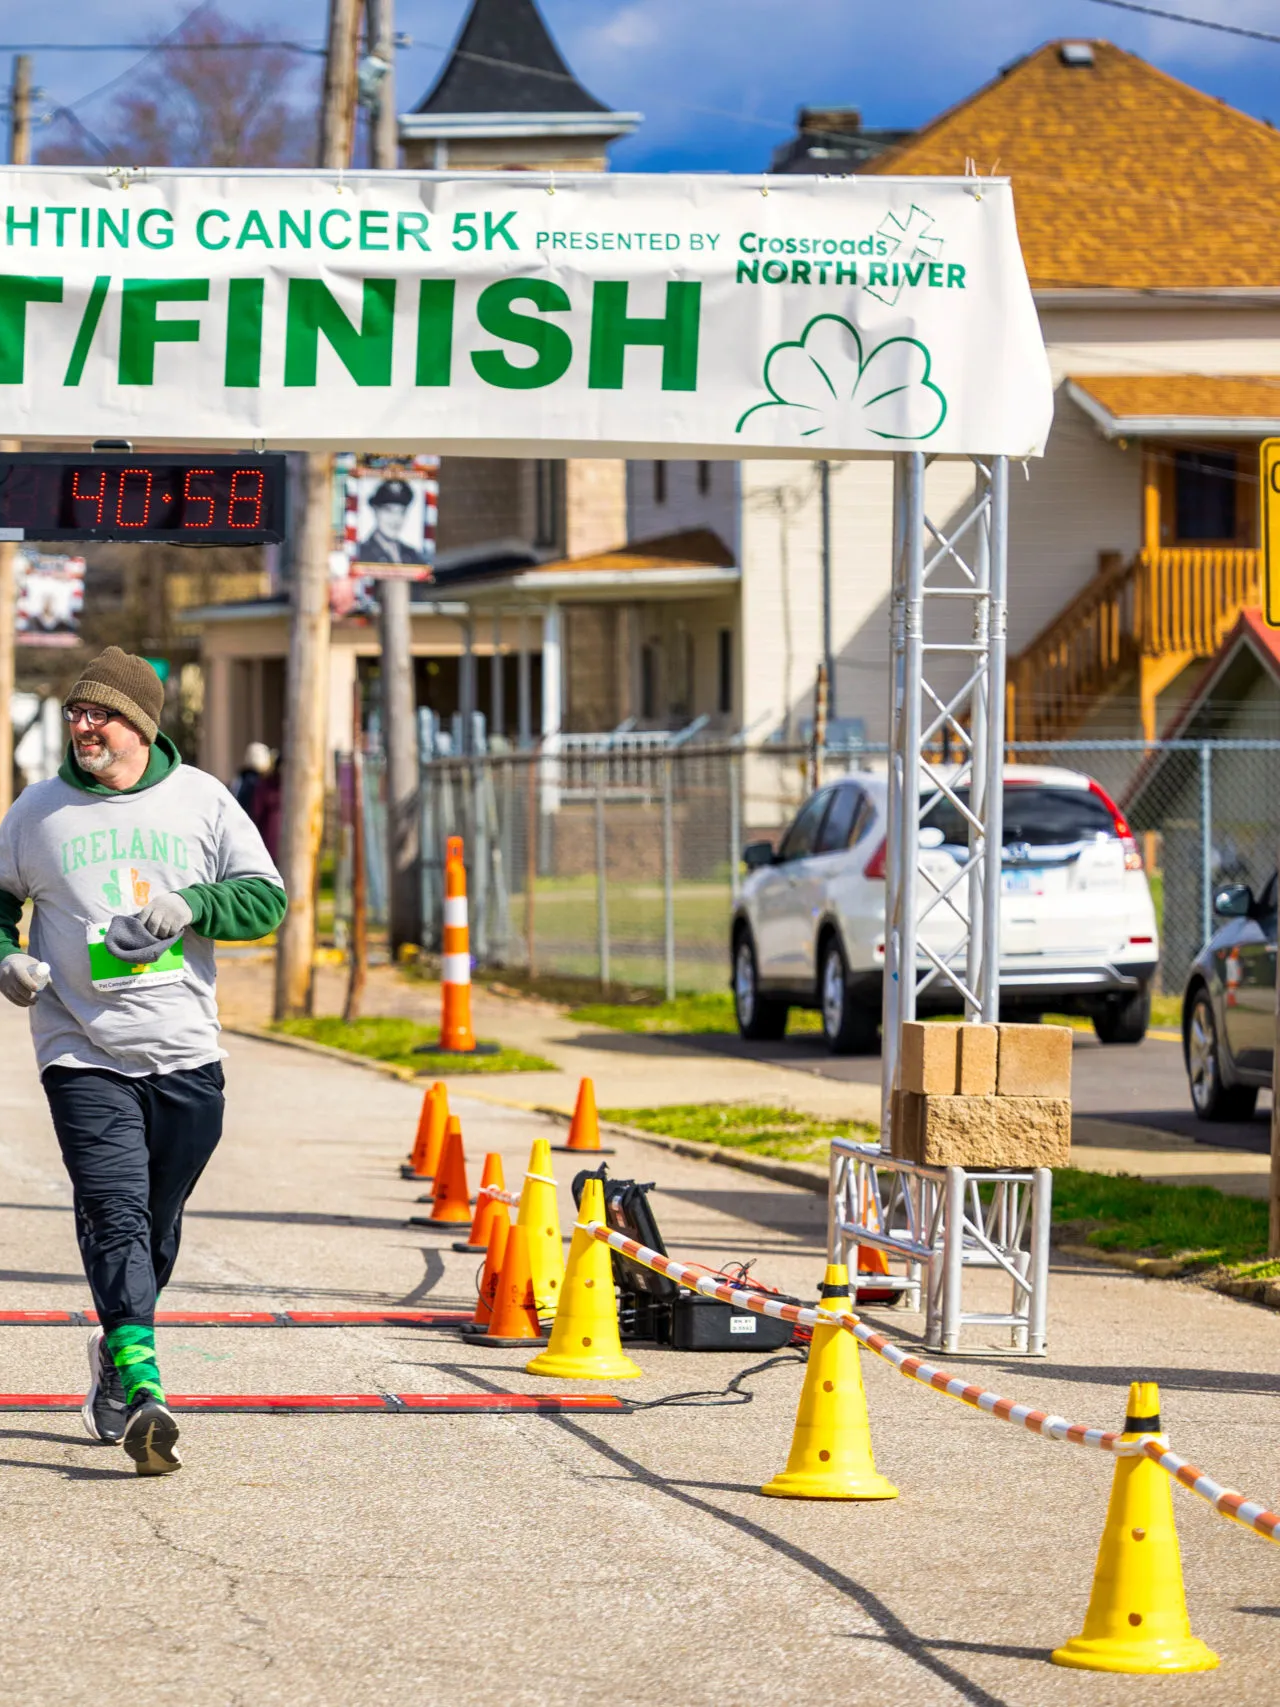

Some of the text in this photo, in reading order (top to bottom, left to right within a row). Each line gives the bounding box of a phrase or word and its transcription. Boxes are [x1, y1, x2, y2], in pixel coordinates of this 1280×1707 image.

[195, 207, 432, 252] CANCER
[451, 210, 519, 252] 5K
[536, 230, 680, 252] PRESENTED
[689, 232, 720, 251] BY
[738, 231, 888, 257] Crossroads
[735, 259, 967, 290] NORTH RIVER
[61, 826, 189, 875] IRELAND
